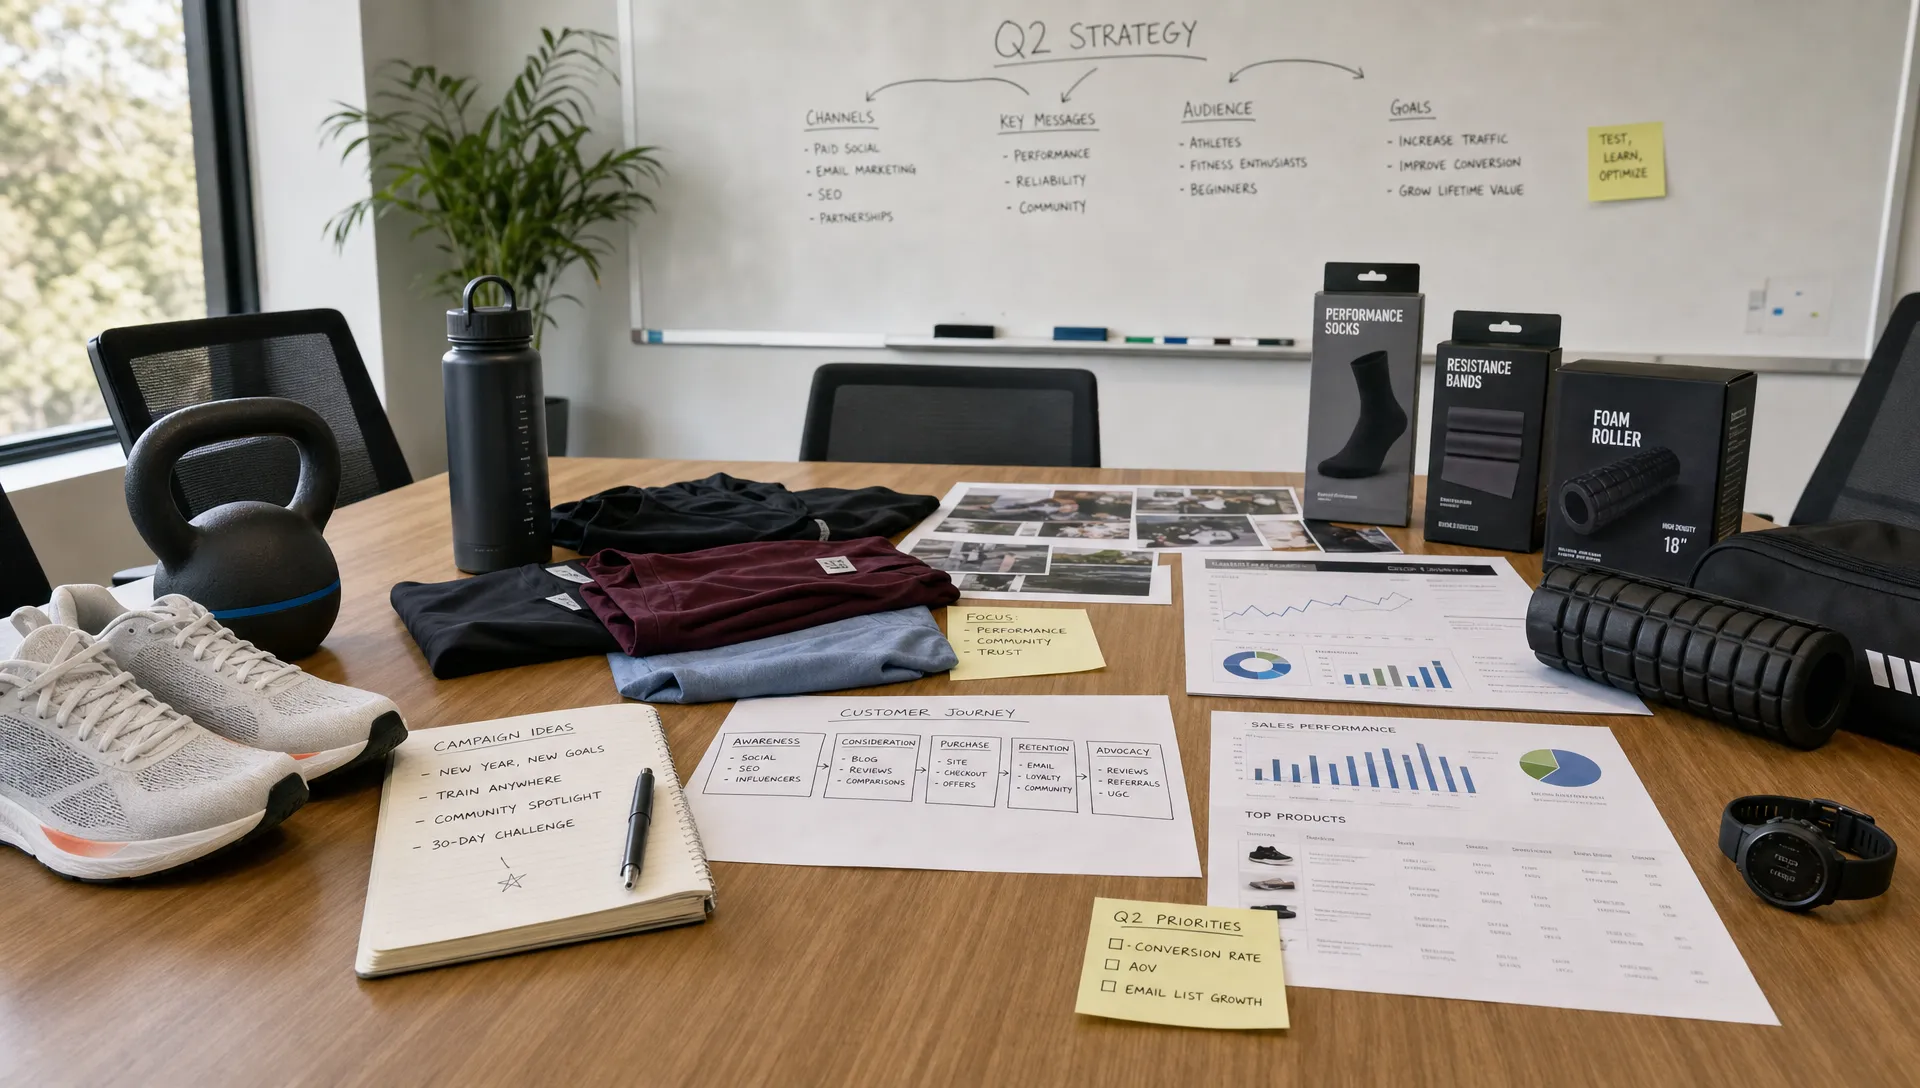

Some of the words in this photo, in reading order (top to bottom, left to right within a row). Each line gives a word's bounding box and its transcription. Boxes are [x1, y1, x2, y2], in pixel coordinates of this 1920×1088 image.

[994, 19, 1051, 60] Q2
[1069, 21, 1198, 50] STRATEGY
[1183, 101, 1253, 117] AUDIENCE
[1390, 100, 1432, 116] GOALS
[806, 110, 874, 125] CHANNELS
[1000, 114, 1025, 129] KEY
[1034, 113, 1095, 127] MESSAGES
[1189, 137, 1242, 149] ATHLETES
[1399, 135, 1453, 147] INCREASE
[1463, 134, 1508, 146] TRAFFIC
[1599, 134, 1632, 147] TEST,
[814, 143, 839, 154] PAID
[845, 143, 880, 154] SOCIAL
[1014, 148, 1090, 160] PERFORMANCE
[1190, 159, 1234, 171] FITNESS
[1240, 157, 1308, 170] ENTHUSIASTS
[1399, 159, 1447, 171] IMPROVE
[1454, 157, 1521, 170] CONVERSION
[1603, 151, 1643, 164] LEARN,
[816, 165, 849, 176] EMAIL
[855, 164, 916, 176] MARKETING
[1599, 168, 1648, 182] OPTIMIZE
[1016, 175, 1086, 187] RELIABILITY
[818, 189, 842, 200] SEO
[1190, 183, 1257, 195] BEGINNERS
[1399, 186, 1432, 197] GROW
[1437, 185, 1485, 196] LIFETIME
[1489, 184, 1524, 196] VALUE
[1019, 201, 1086, 214] COMMUNITY
[820, 212, 893, 224] PARTNERSHIPS
[1326, 308, 1403, 323] PERFORMANCE
[1325, 322, 1360, 335] SOCKS
[1447, 358, 1512, 375] RESISTANCE
[1446, 374, 1482, 389] BANDS
[1594, 410, 1630, 427] FOAM
[1592, 428, 1641, 447] ROLLER
[1664, 536, 1687, 553] 18"
[966, 613, 1018, 621] FOCUS:
[977, 638, 1051, 646] COMMUNITY
[840, 708, 931, 717] CUSTOMER
[944, 708, 1016, 718] JOURNEY
[1251, 721, 1295, 730] SALES
[1300, 723, 1396, 733] PERFORMANCE
[434, 731, 521, 752] CAMPAIGN
[531, 723, 574, 736] IDEAS
[733, 737, 800, 745] AWARENESS
[940, 740, 990, 749] PURCHASE
[1019, 744, 1069, 752] RETENTION
[1096, 747, 1150, 756] ADVOCACY
[440, 765, 472, 777] NEW
[481, 759, 520, 771] YEAR,
[528, 752, 558, 764] NEW
[565, 745, 605, 758] GOALS
[846, 778, 905, 786] COMPARISONS
[1026, 774, 1060, 782] LOYALTY
[1108, 779, 1160, 787] REFERRALS
[436, 787, 480, 800] TRAIN
[489, 774, 562, 792] ANYWHERE
[1025, 785, 1072, 794] COMMUNITY
[434, 804, 517, 824] COMMUNITY
[529, 790, 602, 810] SPOTLIGHT
[1245, 811, 1271, 819] TOP
[1277, 814, 1346, 823] PRODUCTS
[432, 834, 485, 850] 30-DAY
[495, 819, 575, 840] CHALLENGE
[1114, 911, 1143, 924] Q2
[1157, 914, 1241, 932] PRIORITIES
[1135, 942, 1221, 959] CONVERSION
[1229, 952, 1261, 963] RATE
[1129, 962, 1157, 973] AOV
[1126, 985, 1166, 997] EMAIL
[1174, 990, 1203, 1001] LIST
[1211, 994, 1263, 1006] GROWTH
